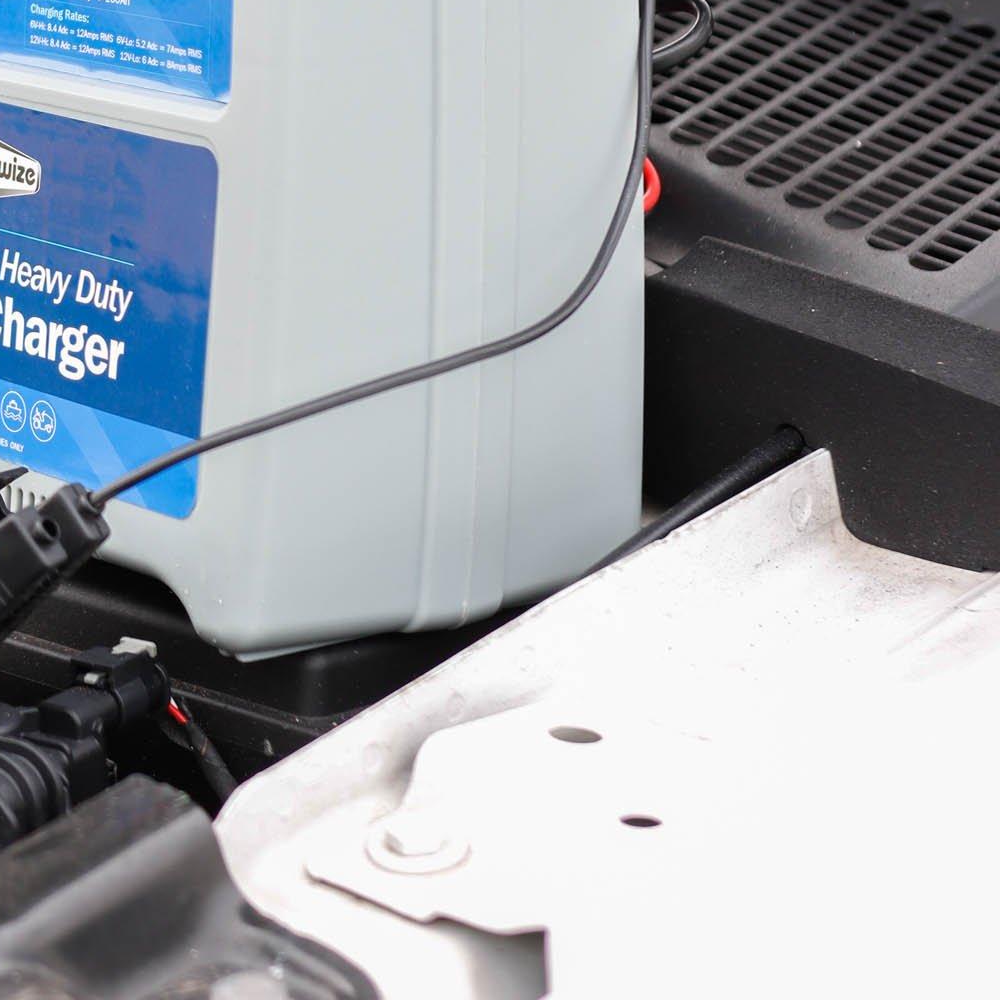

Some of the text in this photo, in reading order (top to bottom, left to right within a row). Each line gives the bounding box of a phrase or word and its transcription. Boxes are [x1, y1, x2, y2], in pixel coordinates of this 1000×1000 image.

[30, 3, 90, 24] Charging Rates:
[47, 22, 57, 32] 8.4
[76, 28, 99, 40] 12Amps
[100, 33, 114, 43] RMS
[135, 38, 146, 49] 5.2
[187, 48, 203, 59] RMS
[49, 38, 60, 48] 8.4
[79, 43, 101, 56] 12Amps
[101, 48, 116, 58] RMS
[141, 55, 147, 65] 6
[187, 64, 202, 75] RMS
[0, 248, 72, 305] Heavy
[75, 268, 134, 322] Duty
[9, 440, 25, 452] ONLY
